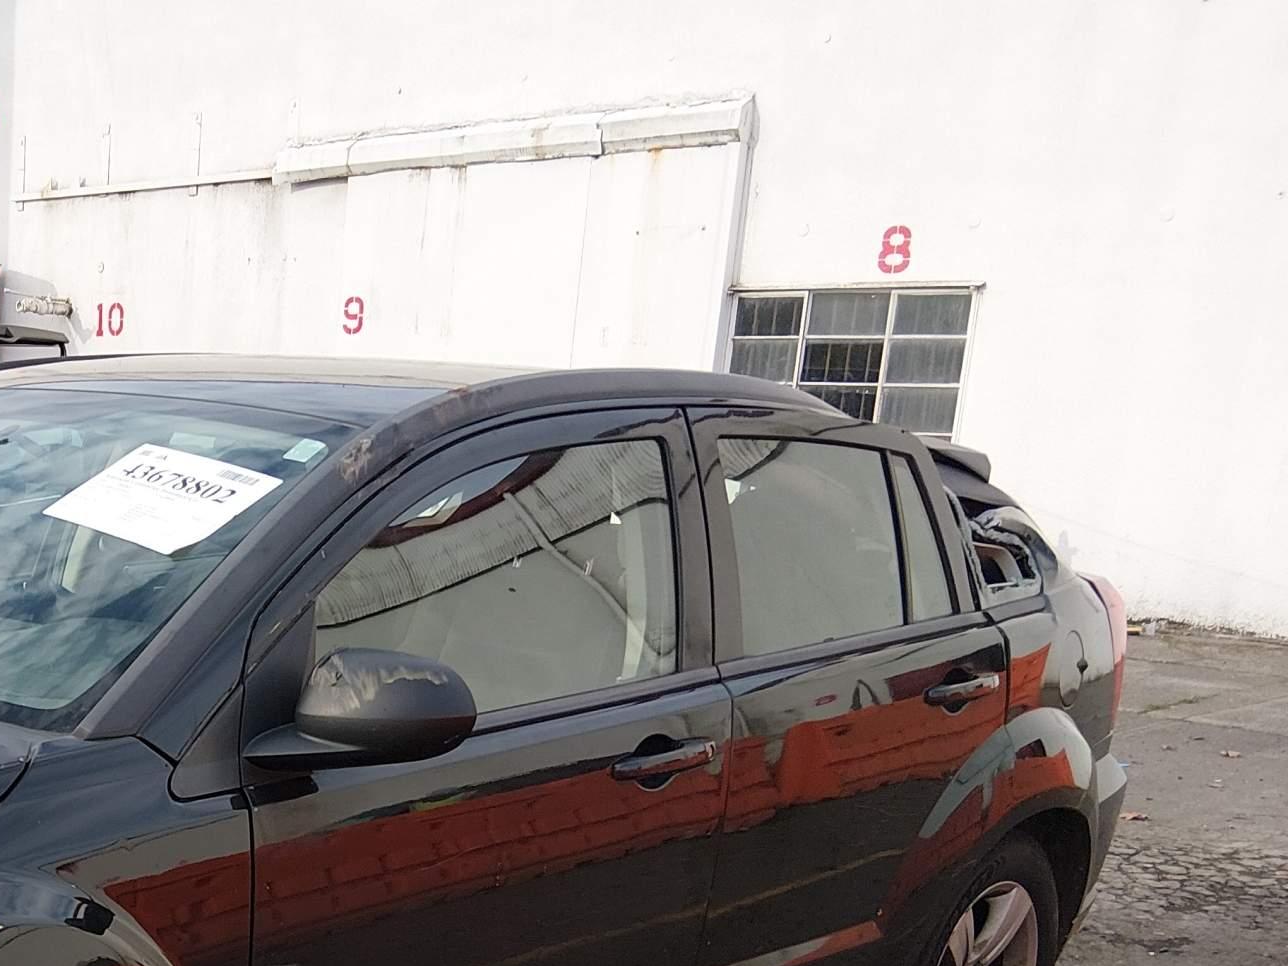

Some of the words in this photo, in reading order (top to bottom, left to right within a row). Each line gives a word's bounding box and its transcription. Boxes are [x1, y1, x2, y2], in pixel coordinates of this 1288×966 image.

[878, 225, 912, 274] 8
[95, 302, 125, 337] 10
[342, 296, 365, 335] 9
[123, 462, 238, 504] 43678802
